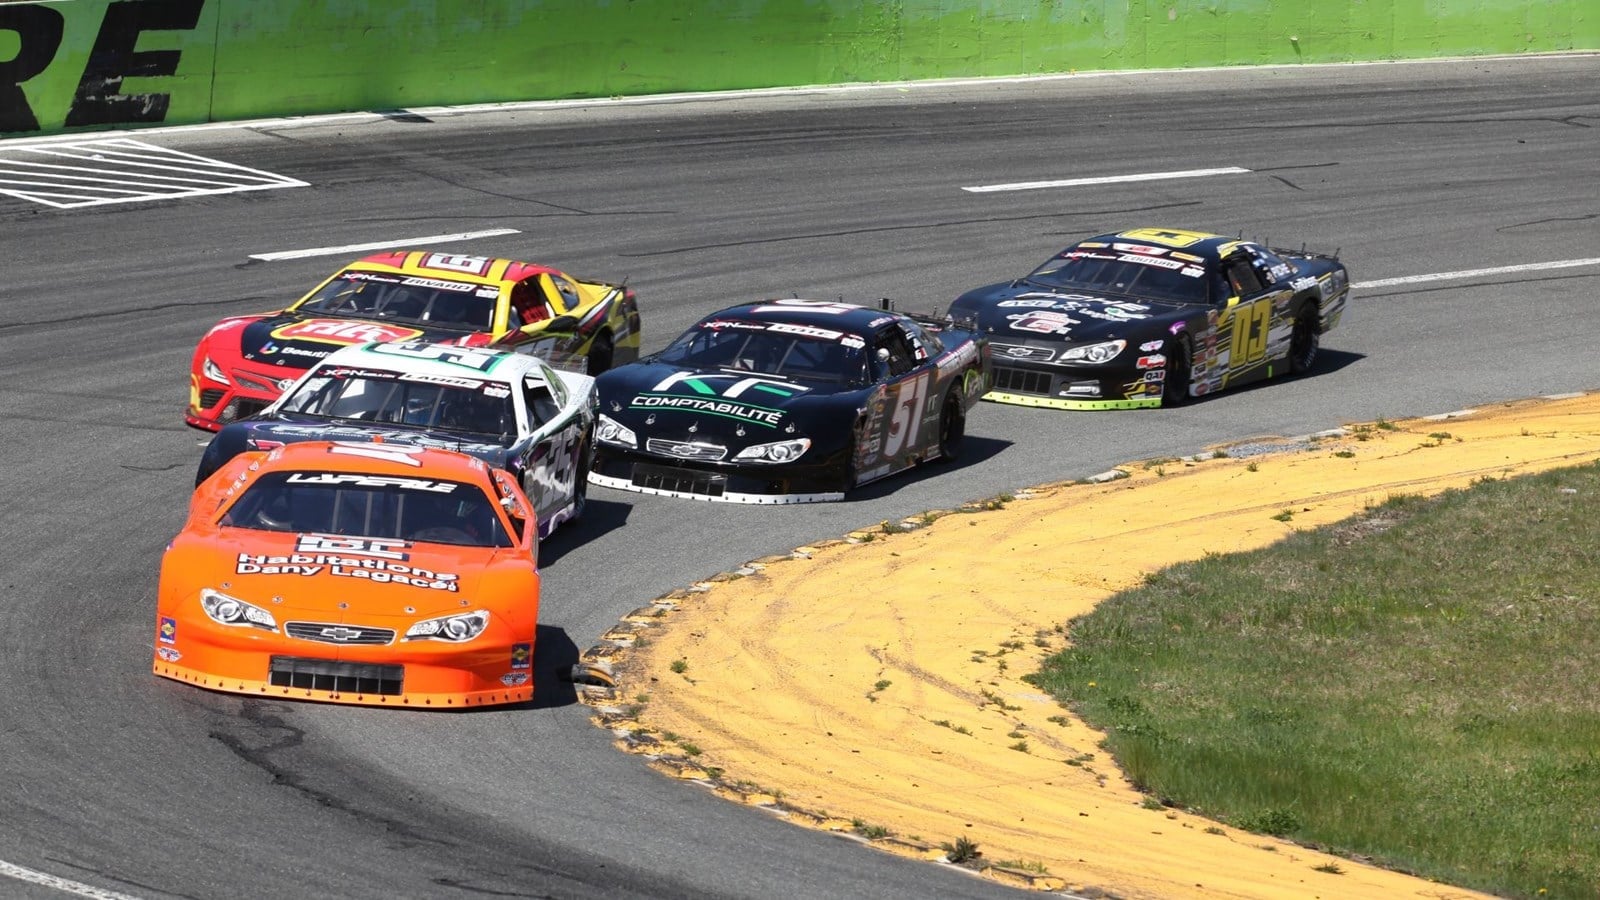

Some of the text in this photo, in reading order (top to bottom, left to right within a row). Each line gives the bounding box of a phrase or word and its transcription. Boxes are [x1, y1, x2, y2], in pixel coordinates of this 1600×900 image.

[408, 278, 472, 291] RIVARD
[1229, 295, 1272, 370] 03
[652, 371, 812, 398] KF
[631, 396, 784, 425] COMPTABILITÉ
[884, 372, 929, 457] 51
[286, 473, 459, 493] LAPERLE
[236, 563, 323, 577] Dany
[237, 553, 458, 581] Habitations
